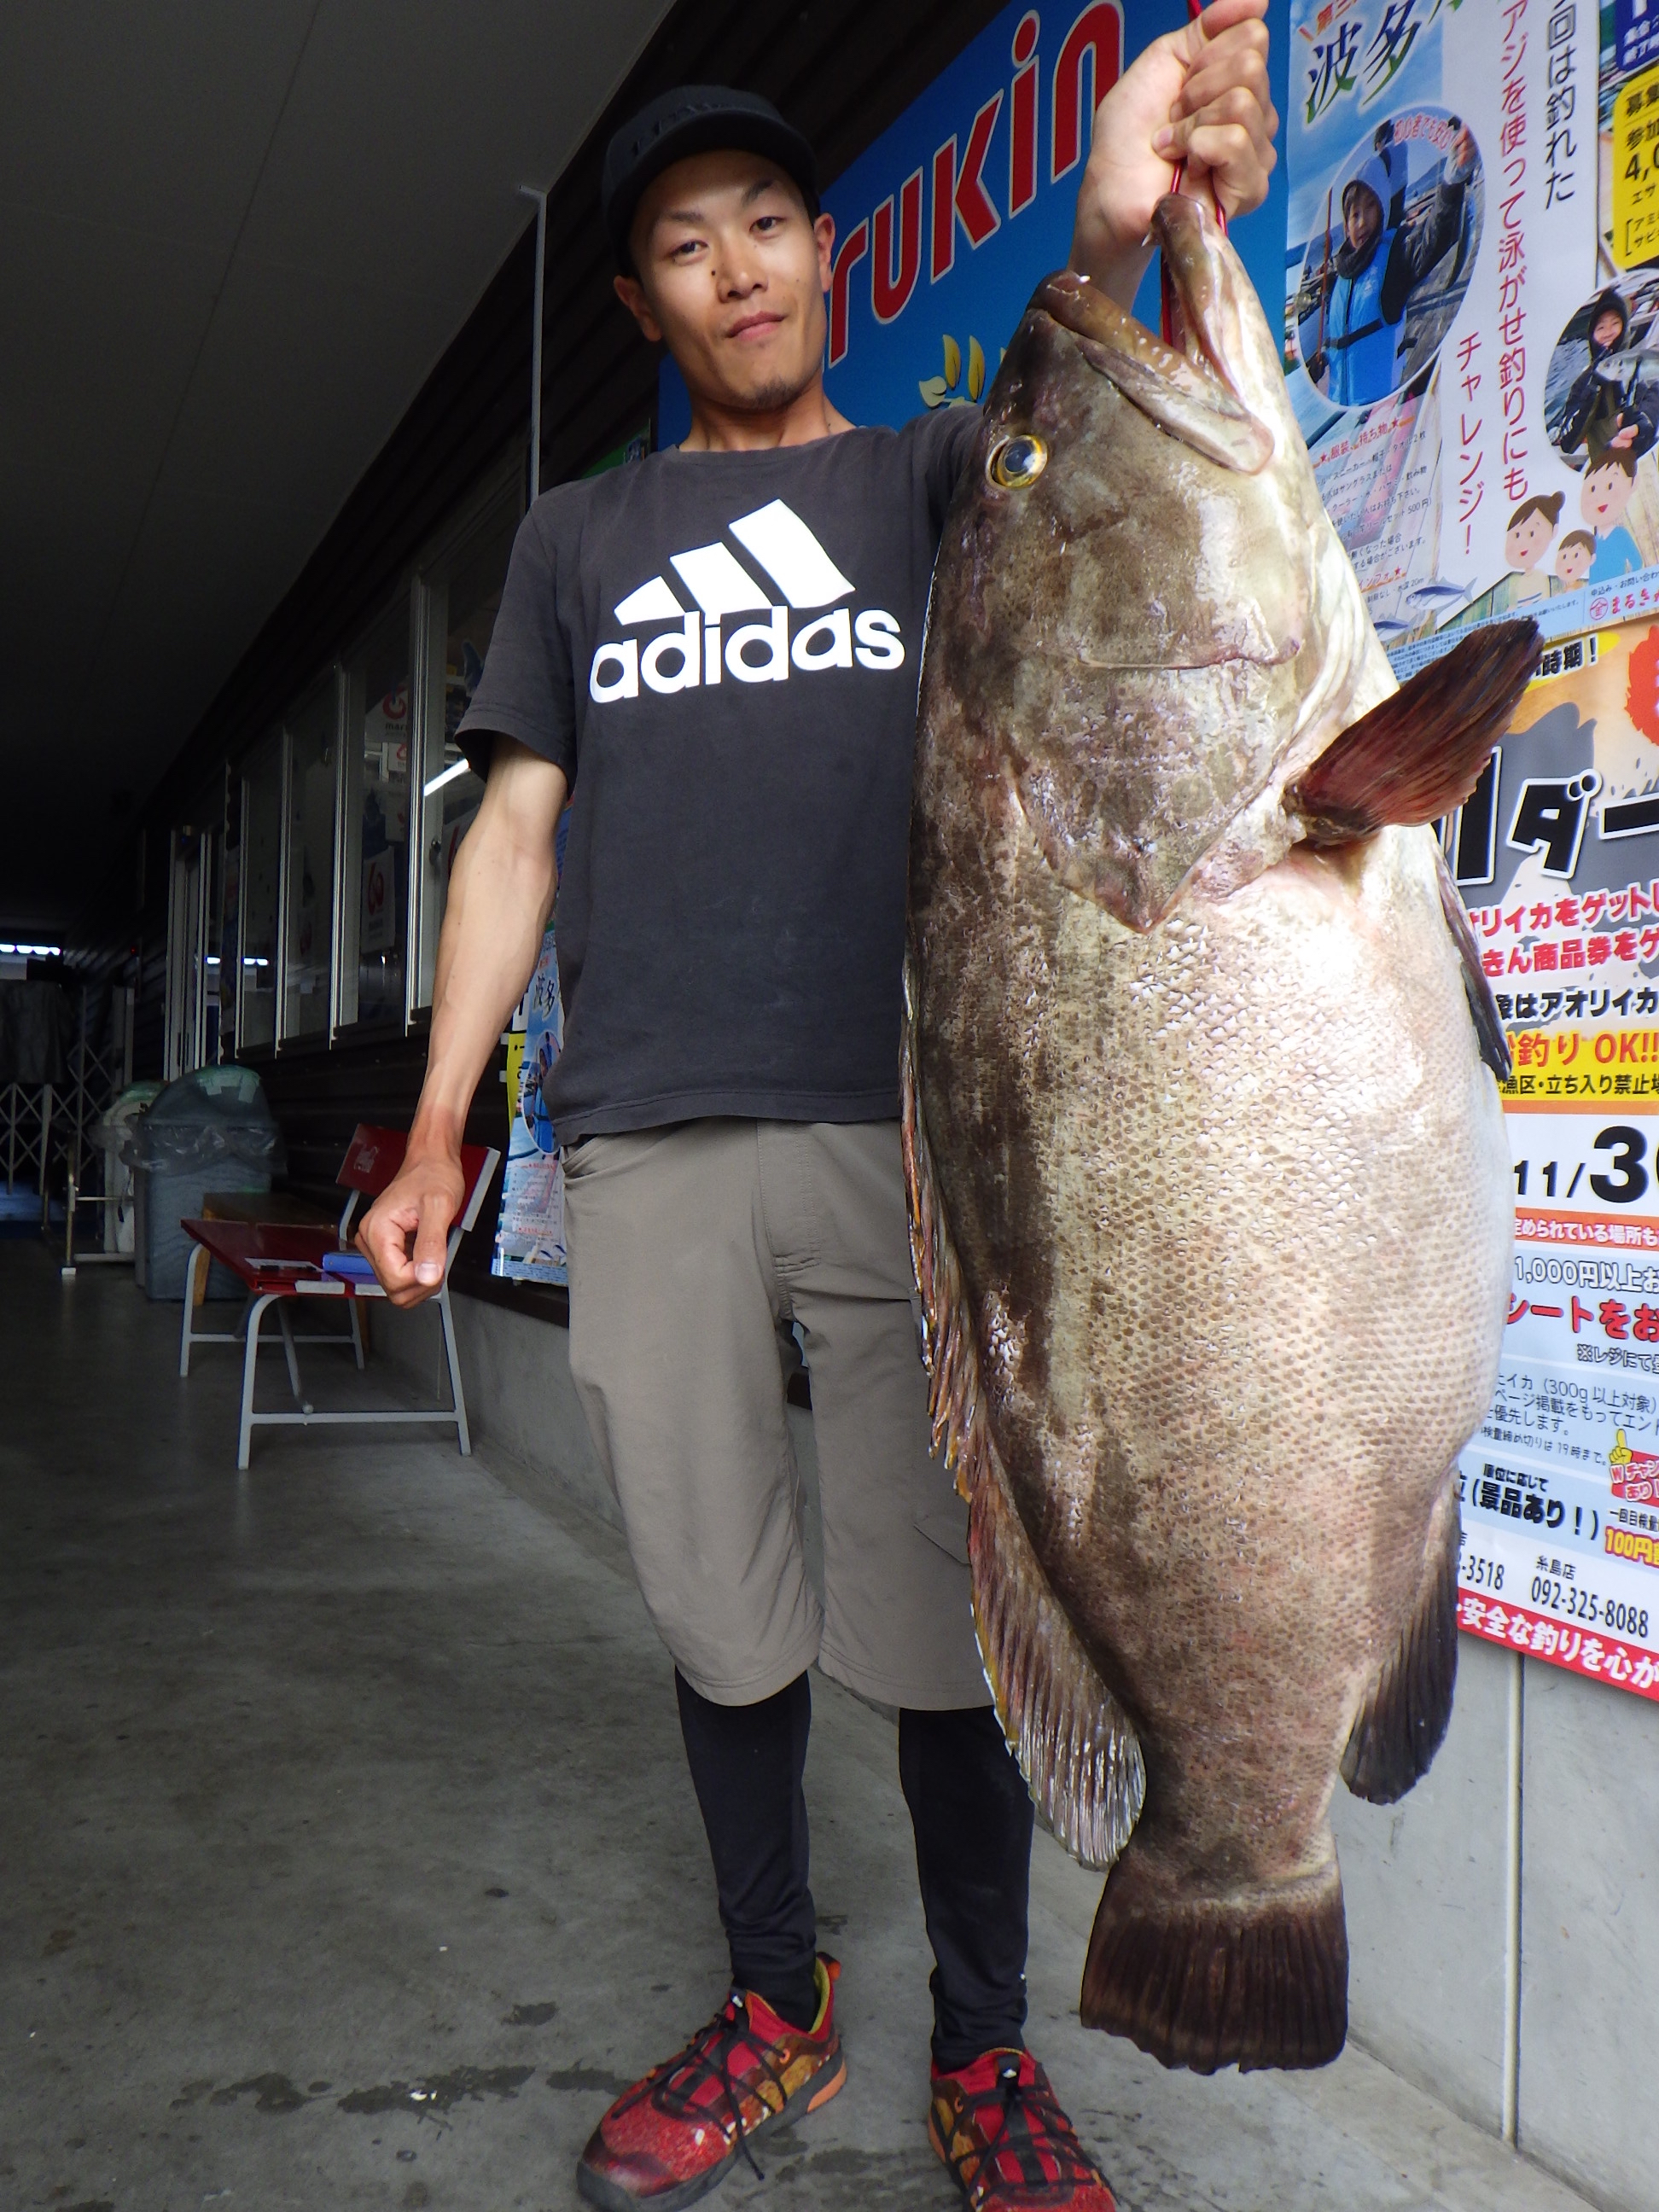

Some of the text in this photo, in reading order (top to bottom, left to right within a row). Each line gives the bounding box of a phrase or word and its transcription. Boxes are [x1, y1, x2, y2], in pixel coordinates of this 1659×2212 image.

[1306, 0, 1463, 125] 波多
[1545, 0, 1577, 211] 回は釣れた
[590, 605, 906, 704] adidas
[1535, 637, 1598, 677] 時期！
[1509, 1032, 1580, 1068] 釣り
[1514, 1126, 1659, 1203] 11/3
[1459, 1554, 1505, 1591] -3518
[1531, 1575, 1650, 1639] 092-325-8088
